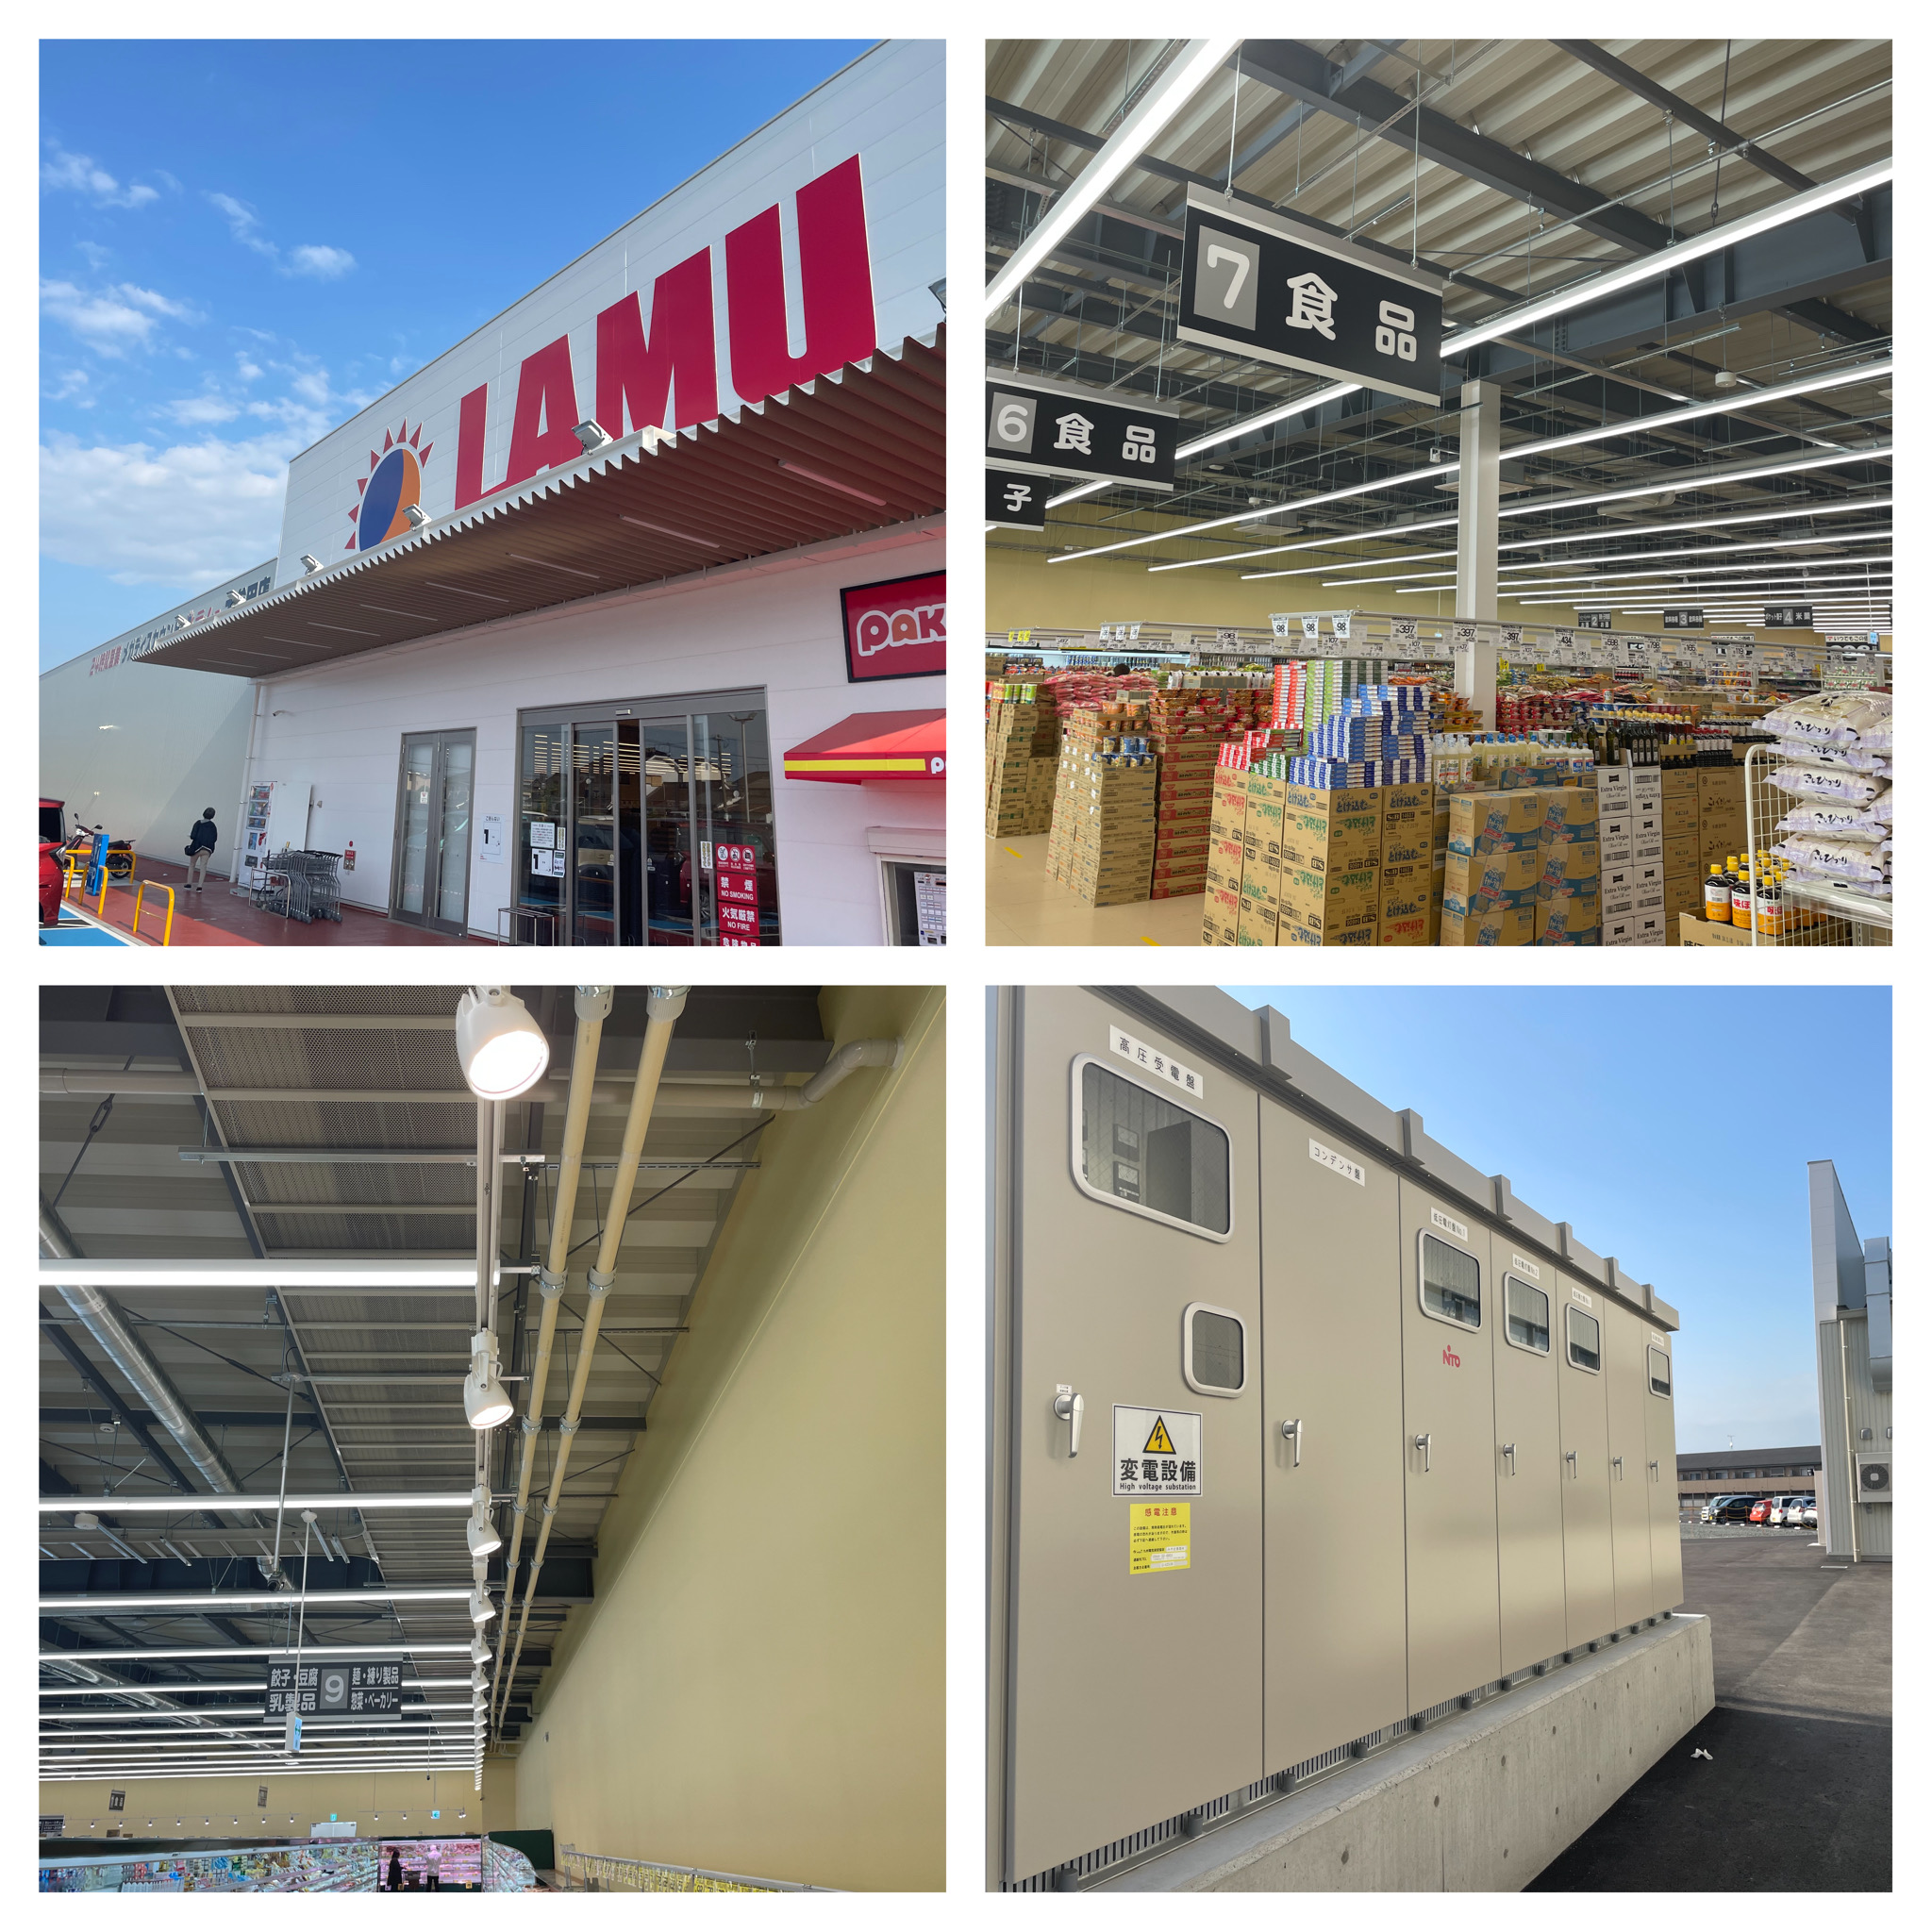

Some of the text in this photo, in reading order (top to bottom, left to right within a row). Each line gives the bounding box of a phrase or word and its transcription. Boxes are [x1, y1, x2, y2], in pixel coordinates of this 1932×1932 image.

[1207, 243, 1417, 362] 7 食品
[456, 153, 877, 510] LAMU
[997, 404, 1157, 463] 6 食品
[1003, 484, 1032, 512] 子
[1591, 616, 1598, 625] 2
[1681, 614, 1686, 625] 3
[1784, 611, 1792, 623] 4
[1276, 625, 1285, 633] 98
[1306, 623, 1315, 632] 98
[1337, 623, 1346, 631] 98
[1399, 625, 1415, 633] 397
[1461, 628, 1474, 637] 397
[1507, 633, 1519, 641] 397
[720, 876, 753, 891] 禁煙
[730, 891, 753, 900] SMOKING
[722, 907, 755, 923] 火気厳禁
[737, 923, 750, 931] FIRE
[1649, 929, 1664, 937] Virgin
[1618, 936, 1632, 944] Virgin
[1119, 1036, 1195, 1090] 高圧受電盤
[1314, 1146, 1361, 1180] コンデンサ盤
[1120, 1458, 1196, 1482] 変電設備
[1120, 1482, 1135, 1491] High
[1139, 1483, 1163, 1491] voltage
[1145, 1507, 1177, 1516] 感電注意
[271, 1666, 399, 1703] 餃子・豆腐 9 麺・練り製品
[269, 1691, 398, 1713] 乳製品 惣菜・ベーカリー
